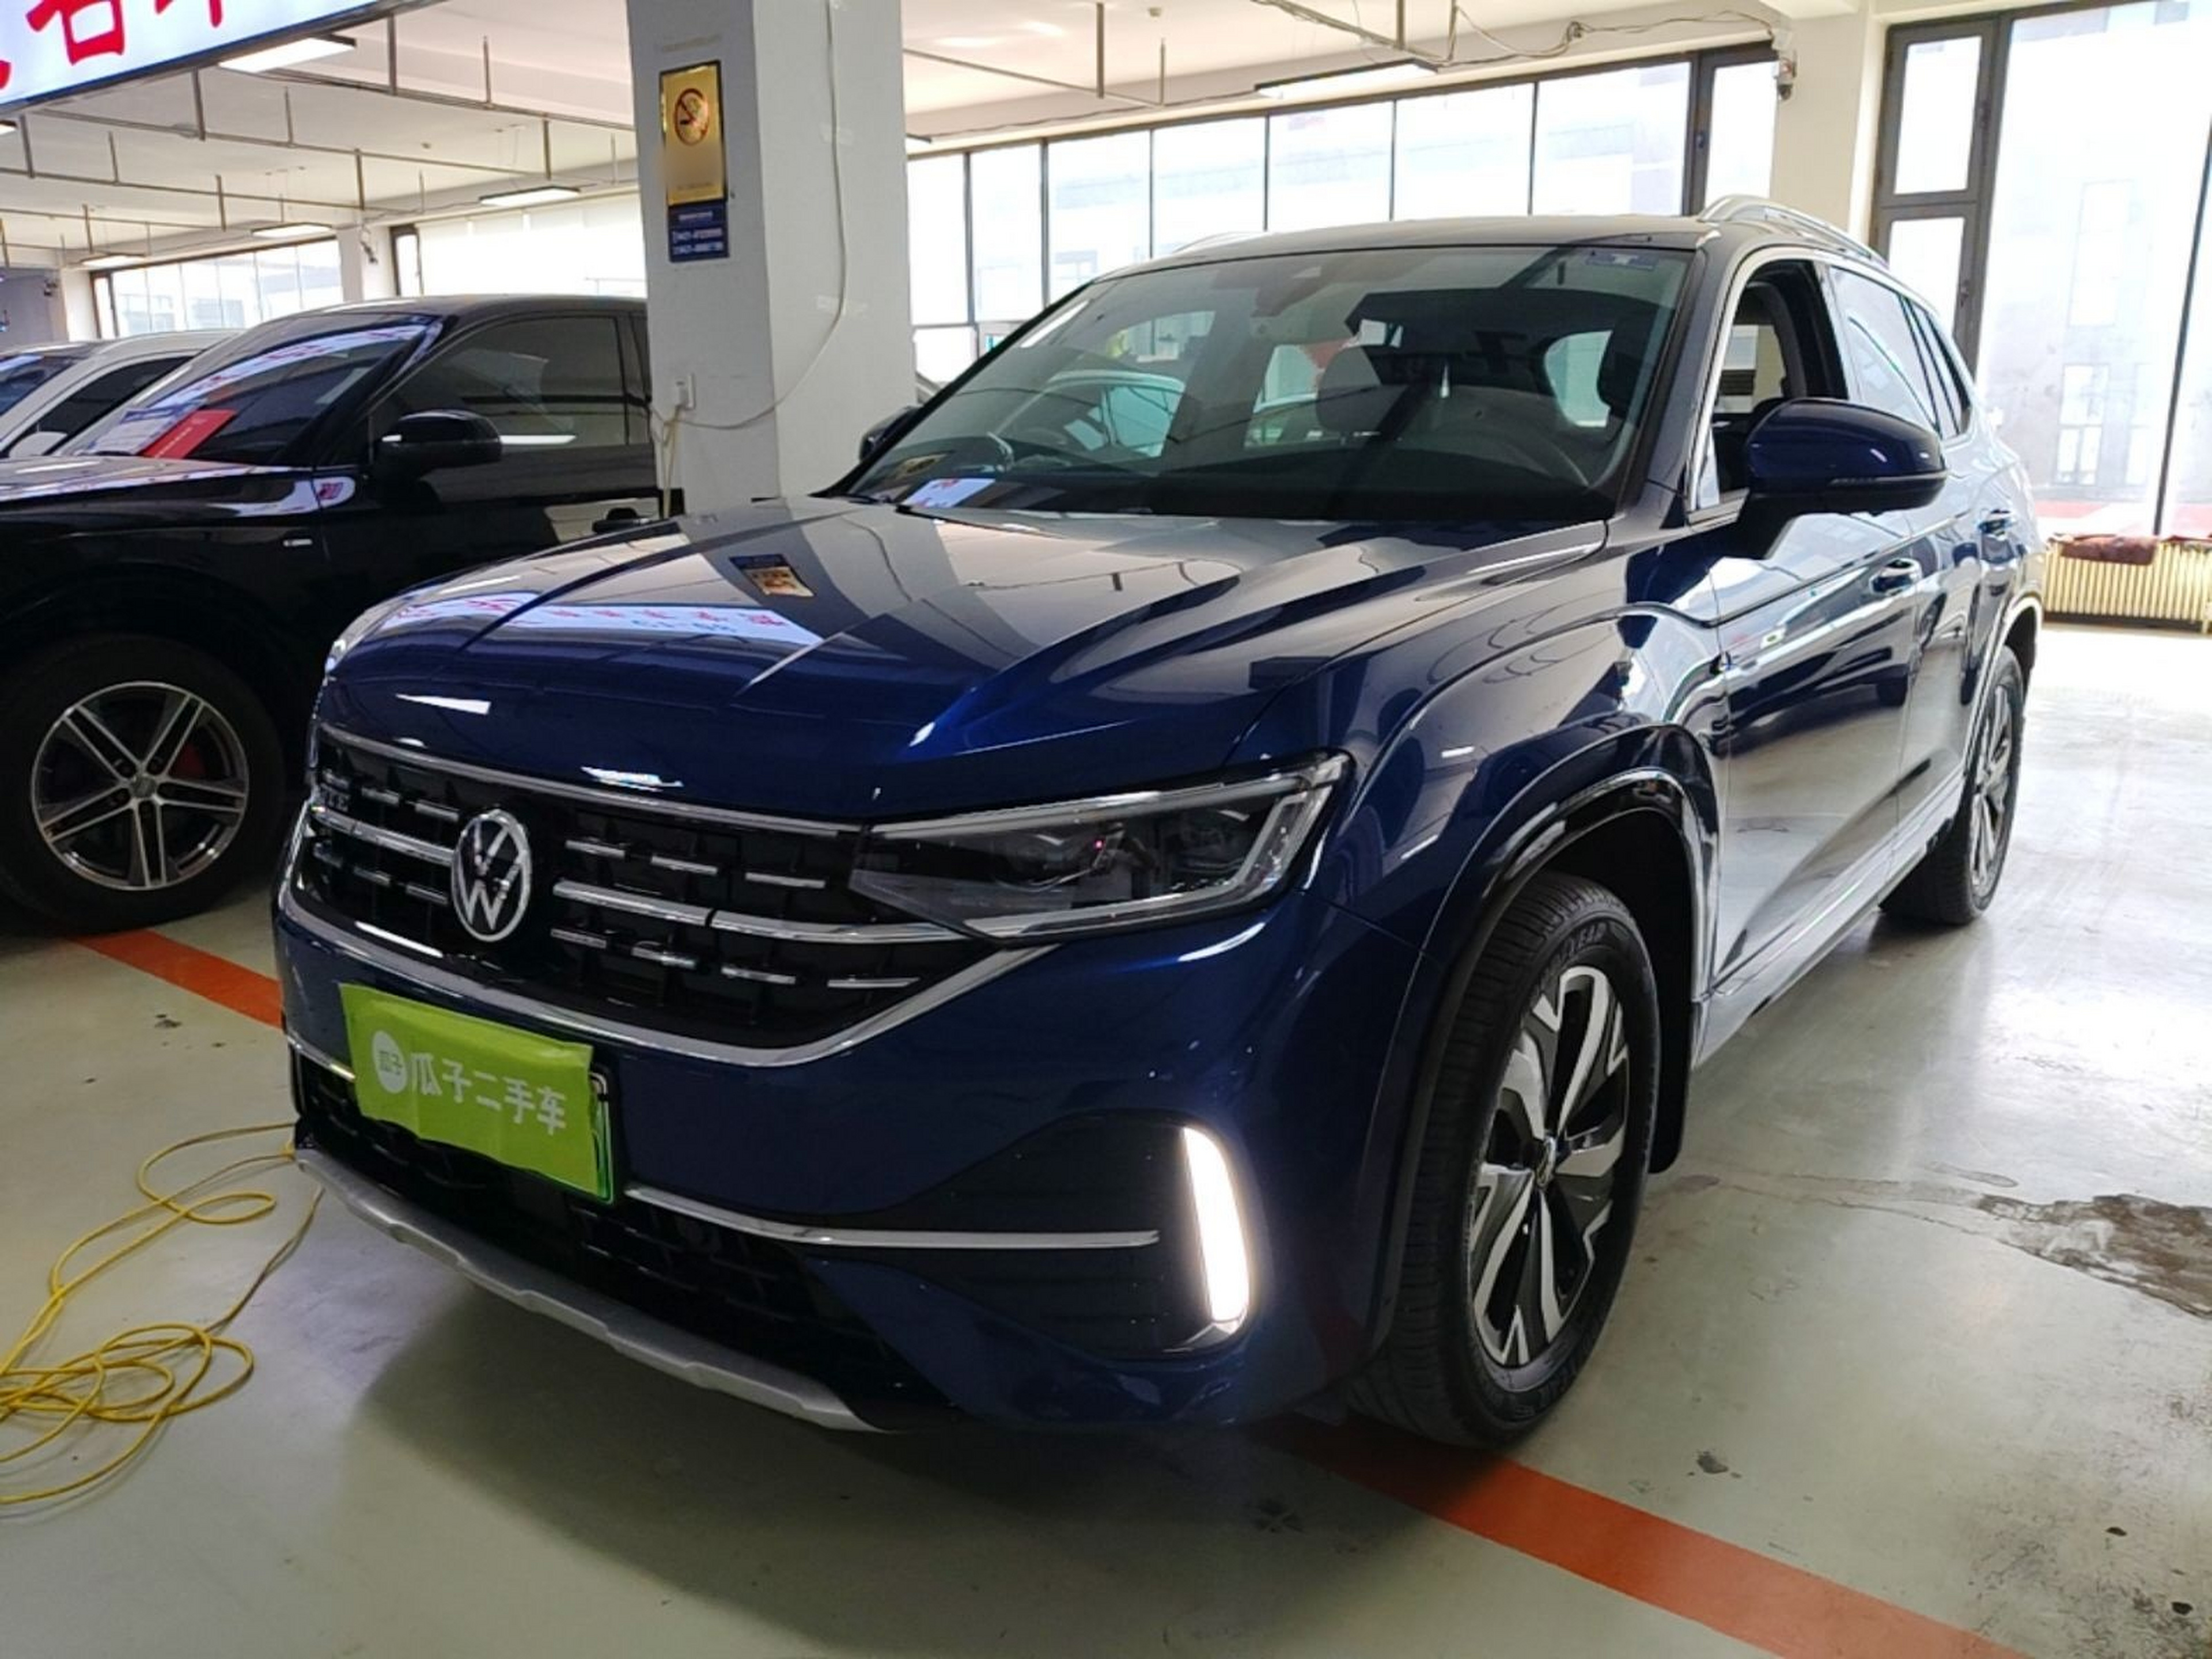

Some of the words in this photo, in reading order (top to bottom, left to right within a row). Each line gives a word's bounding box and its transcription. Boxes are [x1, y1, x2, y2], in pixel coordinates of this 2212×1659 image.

[410, 1052, 567, 1135] 瓜子二手车
